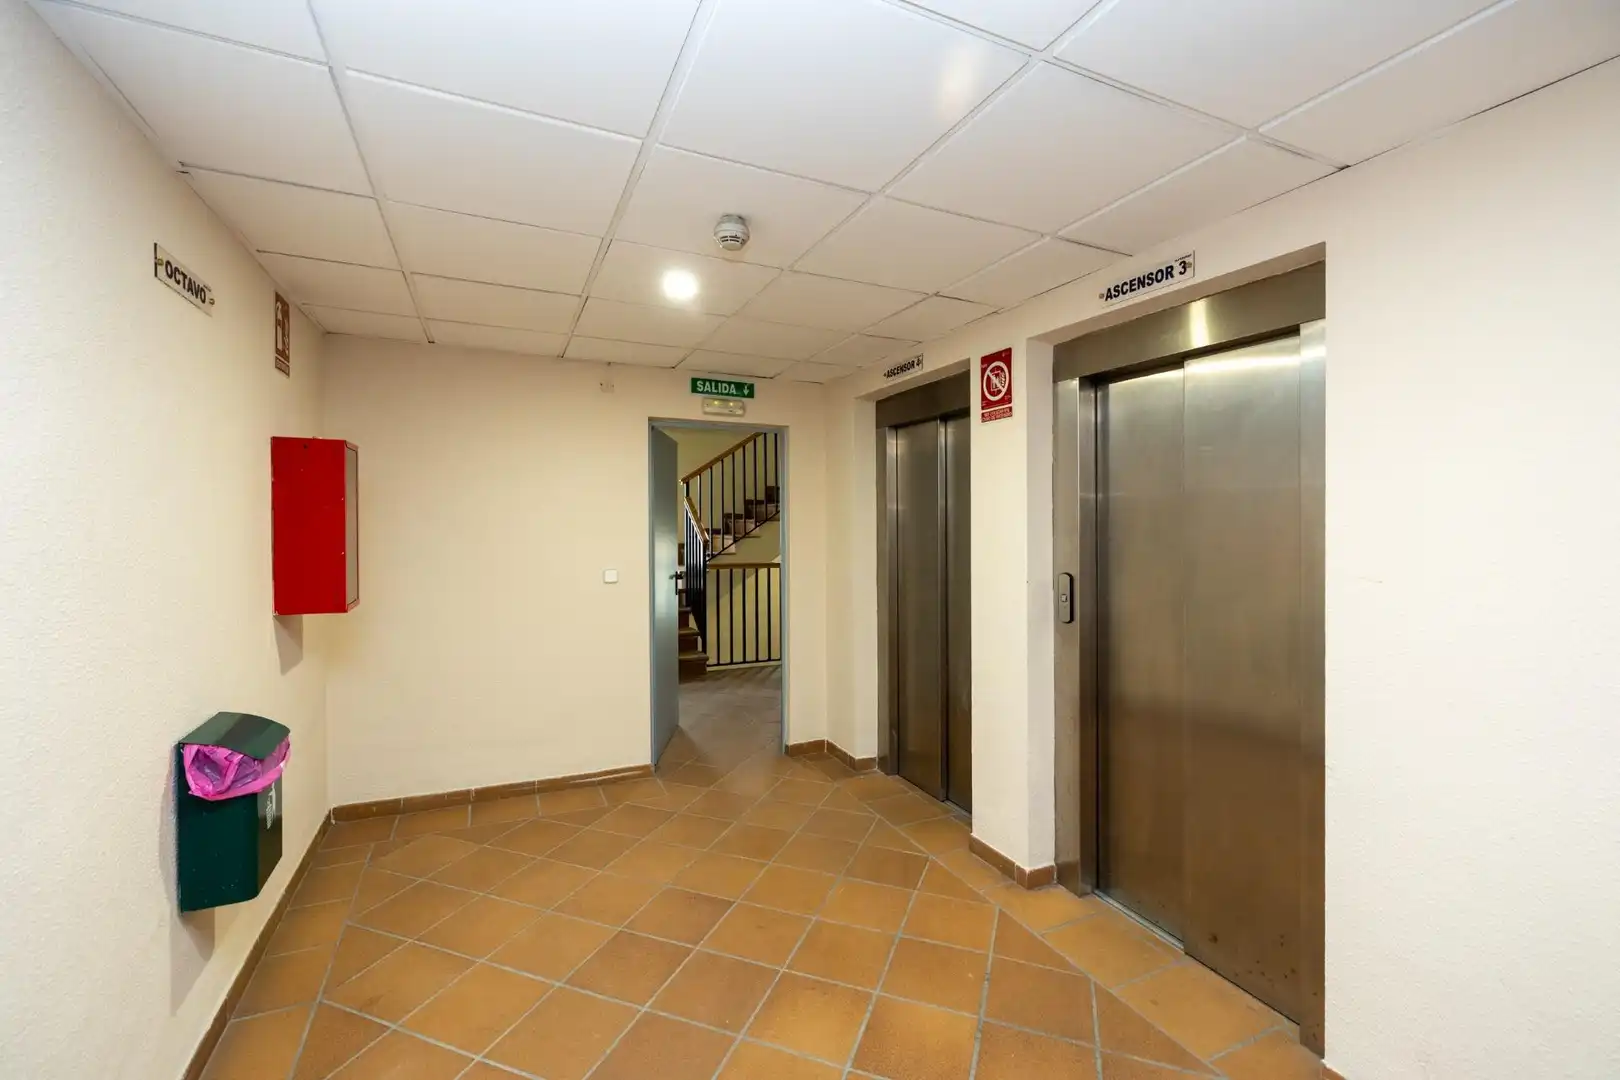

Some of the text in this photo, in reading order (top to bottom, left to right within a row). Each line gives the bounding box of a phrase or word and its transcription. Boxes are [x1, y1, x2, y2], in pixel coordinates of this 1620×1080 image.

[165, 259, 206, 304] OCTAVO
[1105, 260, 1187, 302] ASCENSOR 3
[886, 359, 915, 379] ASCENSOR
[696, 380, 737, 395] SALIDA
